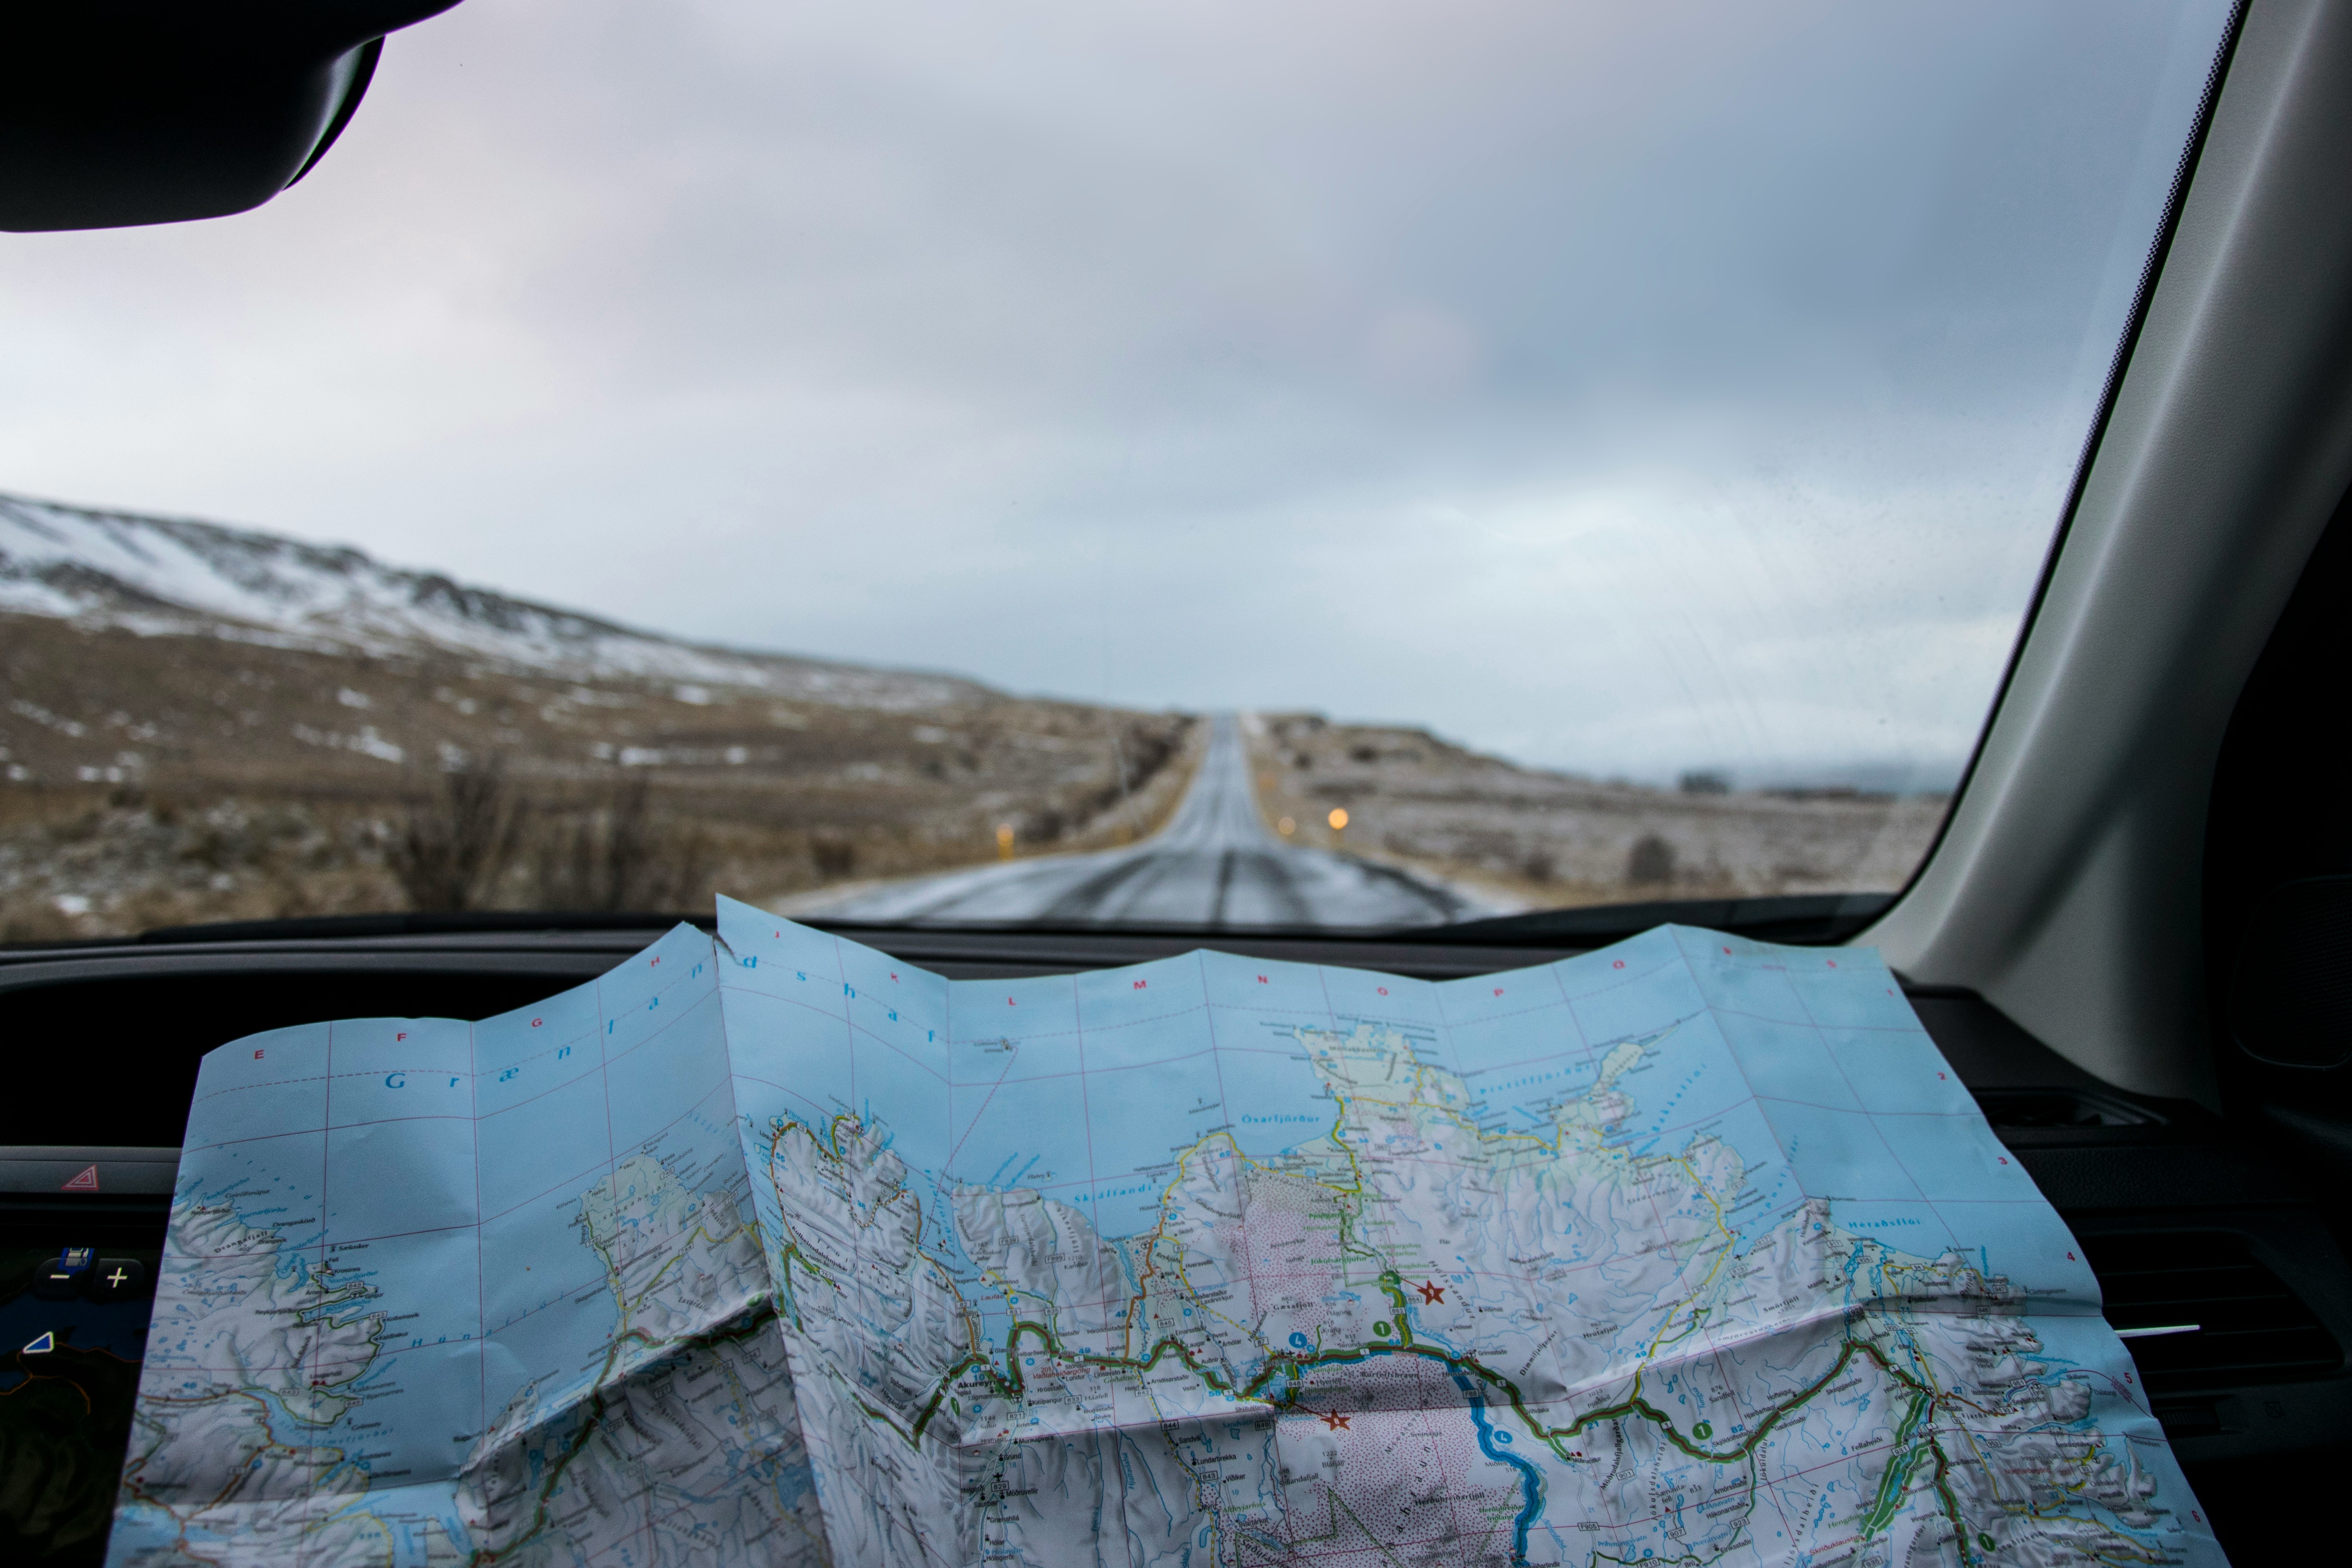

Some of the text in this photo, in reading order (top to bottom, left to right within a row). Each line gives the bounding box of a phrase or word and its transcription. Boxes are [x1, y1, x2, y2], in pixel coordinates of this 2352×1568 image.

[1134, 980, 1147, 989] M
[1257, 975, 1268, 984] N
[1377, 987, 1388, 996] O
[1008, 997, 1016, 1006] L
[531, 1018, 543, 1027] G
[397, 1033, 407, 1042] F
[254, 1050, 265, 1060] E
[272, 1218, 315, 1227] Drangaskörð
[215, 1231, 268, 1253] Drangafjall
[2067, 1252, 2076, 1261] 4
[1175, 1326, 1207, 1335] Einarsstaðir
[1519, 1330, 1557, 1377] Dimmifjallgarður
[1033, 1368, 1090, 1379] Vaðlaheiðargöng
[1104, 1374, 1137, 1384] Goðafoss
[2124, 1372, 2133, 1384] 5
[958, 1380, 996, 1388] Akureyri
[1152, 1375, 1189, 1384] Arndísarstaðir
[890, 1377, 912, 1396] Staðarbakki
[1826, 1378, 1863, 1395] Skeggjastaðir
[881, 1389, 907, 1410] Hörgárdalur
[1709, 1391, 1735, 1403] Sandfell
[1767, 1389, 1792, 1401] Hofteigur
[1744, 1404, 1775, 1419] Hjarðarhagi
[1587, 1420, 1599, 1430] 21
[1774, 1417, 1806, 1431] Gauksstaðir
[1698, 1426, 1704, 1436] 1
[1713, 1430, 1754, 1447] Skjöldólfsstaðir
[1851, 1437, 1883, 1451] Fellaheiði
[1894, 1446, 1907, 1455] 931
[1197, 1454, 1236, 1465] Lundarbrekka
[1226, 1474, 1245, 1482] Víðiker
[1280, 1474, 1318, 1487] Sellandafjall
[1714, 1478, 1748, 1495] Arnórsstaðir
[1223, 1502, 1266, 1513] Aldeyjarfoss
[1479, 1505, 1524, 1513] Herðubreiðar
[1856, 1498, 1876, 1510] Brekka
[1706, 1502, 1745, 1519] Hákonarstaðir
[2192, 1510, 2200, 1522] 6
[1238, 1518, 1269, 1527] Svartárkot
[1733, 1518, 1747, 1528] 923
[1828, 1514, 1864, 1529] Hengifoss
[1720, 1539, 1752, 1553] Eiríksstaðir
[1810, 1535, 1862, 1555] Skriðuklaustur
[1464, 1555, 1504, 1566] Herðubreið
